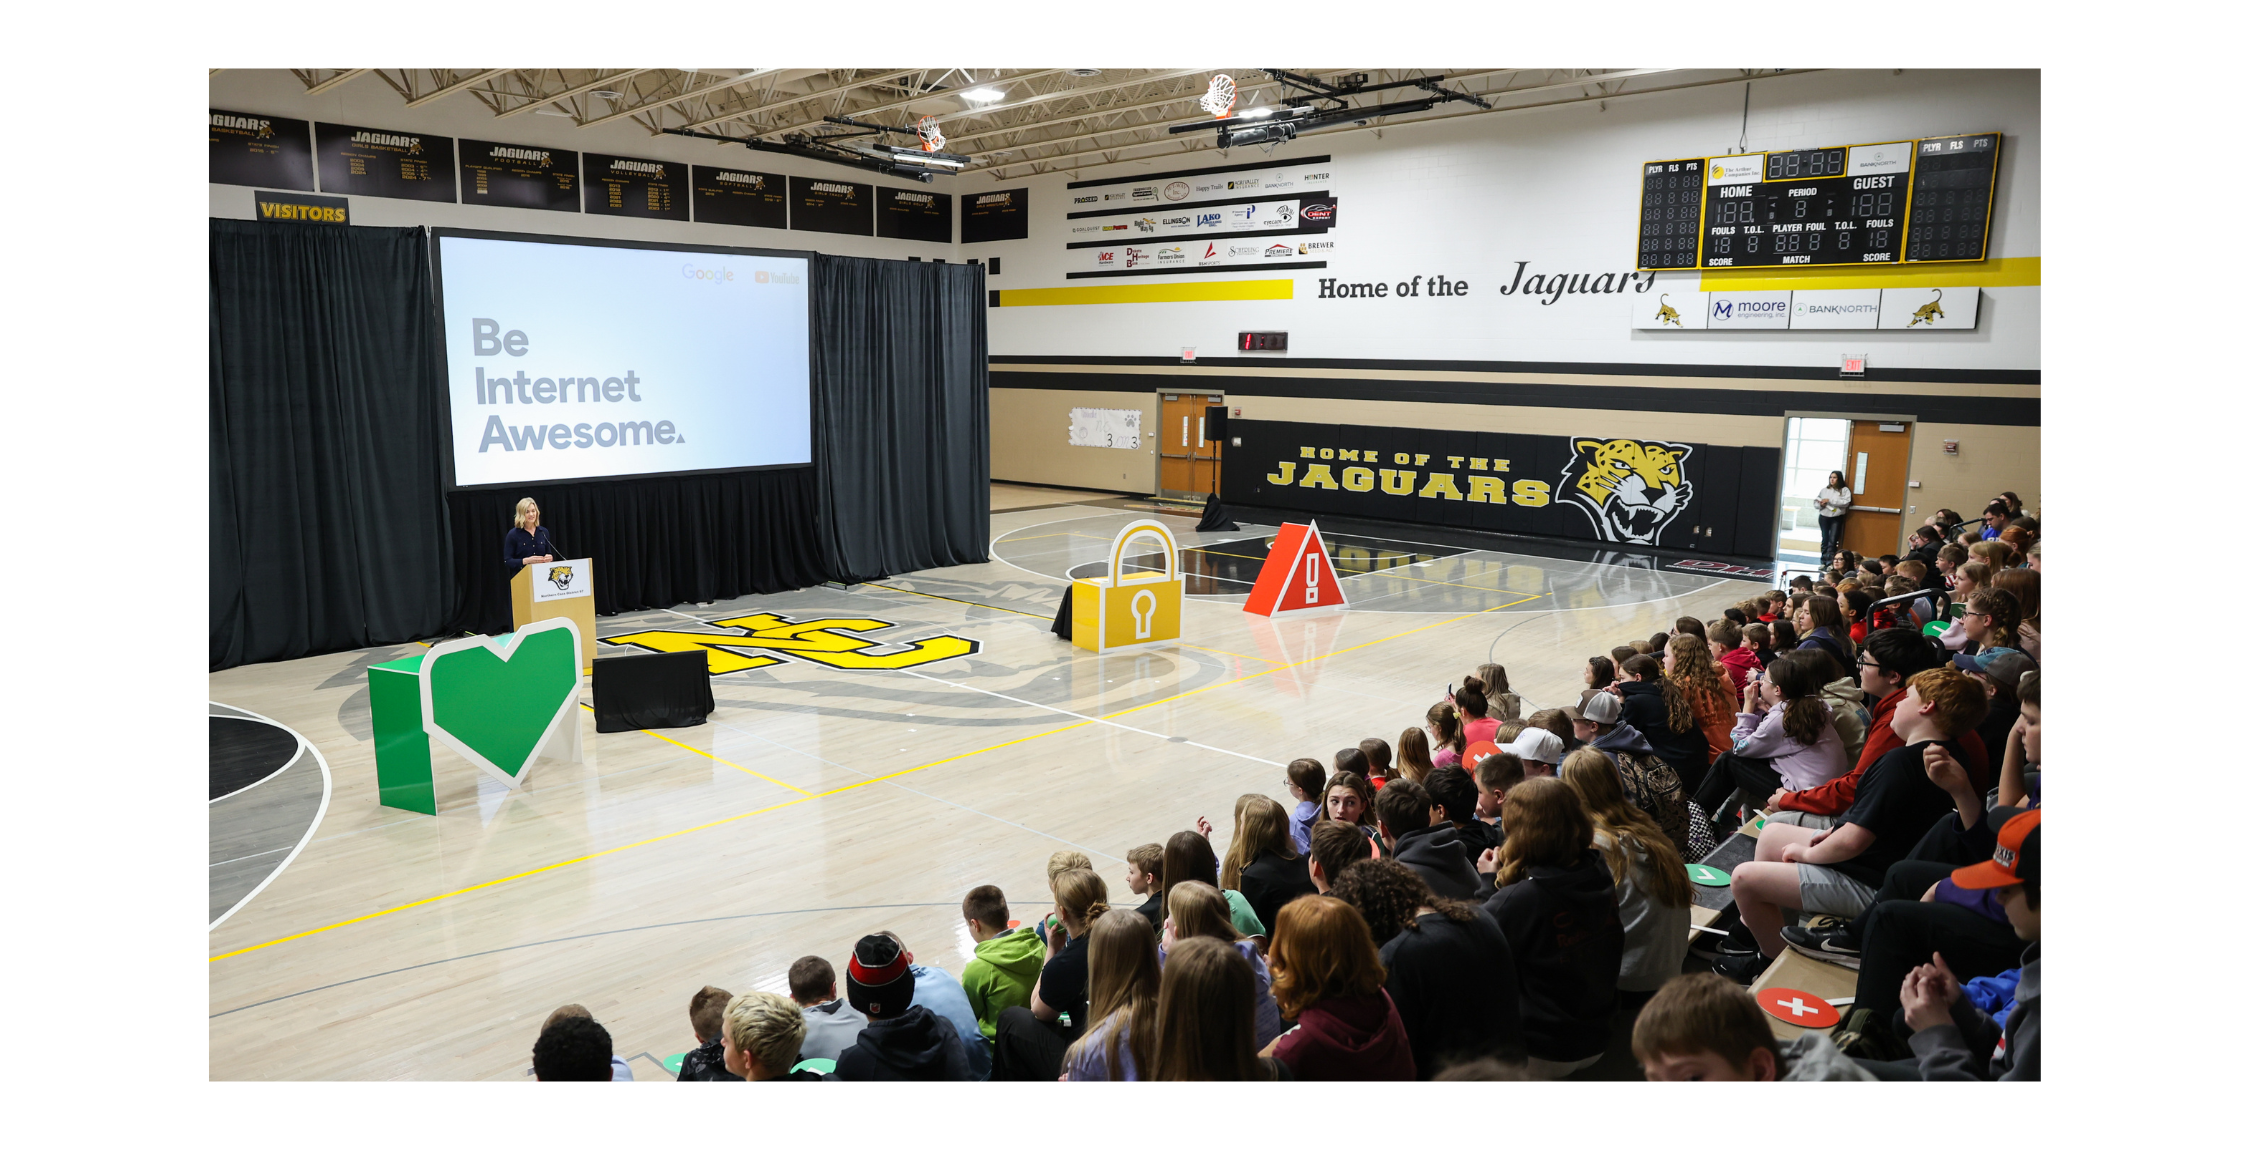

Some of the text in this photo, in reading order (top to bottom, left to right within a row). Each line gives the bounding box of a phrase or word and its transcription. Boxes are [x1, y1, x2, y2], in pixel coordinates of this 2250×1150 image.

[212, 127, 255, 137] BASKETBALL
[351, 131, 420, 147] JAGUARS
[1923, 138, 1989, 152] PLYR FLS PTS
[370, 145, 407, 153] BASKETBALL
[490, 146, 550, 161] JAGUARS
[495, 158, 537, 166] FOOTBALL
[610, 159, 663, 173] JAGUARS
[1648, 162, 1698, 174] PLYR FLS PTS
[1860, 160, 1896, 168] BANKNORTH
[610, 170, 654, 178] VOLLEYBALL
[716, 171, 763, 184] JAGUARS
[810, 182, 854, 194] JAGUARS
[1720, 175, 1895, 198] HOME PERIOD GUEST
[895, 192, 933, 203] JAGUARS
[976, 193, 1011, 204] JAGUARS
[259, 202, 346, 223] VISITORS
[1163, 216, 1190, 225] ELLINGSON
[1197, 213, 1221, 228] LAKO
[1711, 219, 1894, 235] FOULS T.O.L. PLAYER FOUL T.O.L. FOULS
[1099, 252, 1114, 261] ACE
[1708, 252, 1891, 267] SCORE MATCH SCORE
[682, 263, 734, 285] Google
[770, 272, 800, 285] YouTube
[1318, 261, 1656, 306] Home of the Jaguars
[1738, 300, 1786, 312] moore
[1809, 304, 1877, 315] BANKNORTH
[1738, 311, 1774, 319] engineering,
[472, 317, 530, 357] Be
[1845, 359, 1862, 371] EXIT
[475, 366, 642, 405] Internet
[1107, 433, 1113, 448] 3
[1130, 436, 1139, 449] 3
[1300, 446, 1510, 472] HOME OF THE
[1267, 461, 1550, 508] JAGUARS
[596, 610, 984, 678] NC
